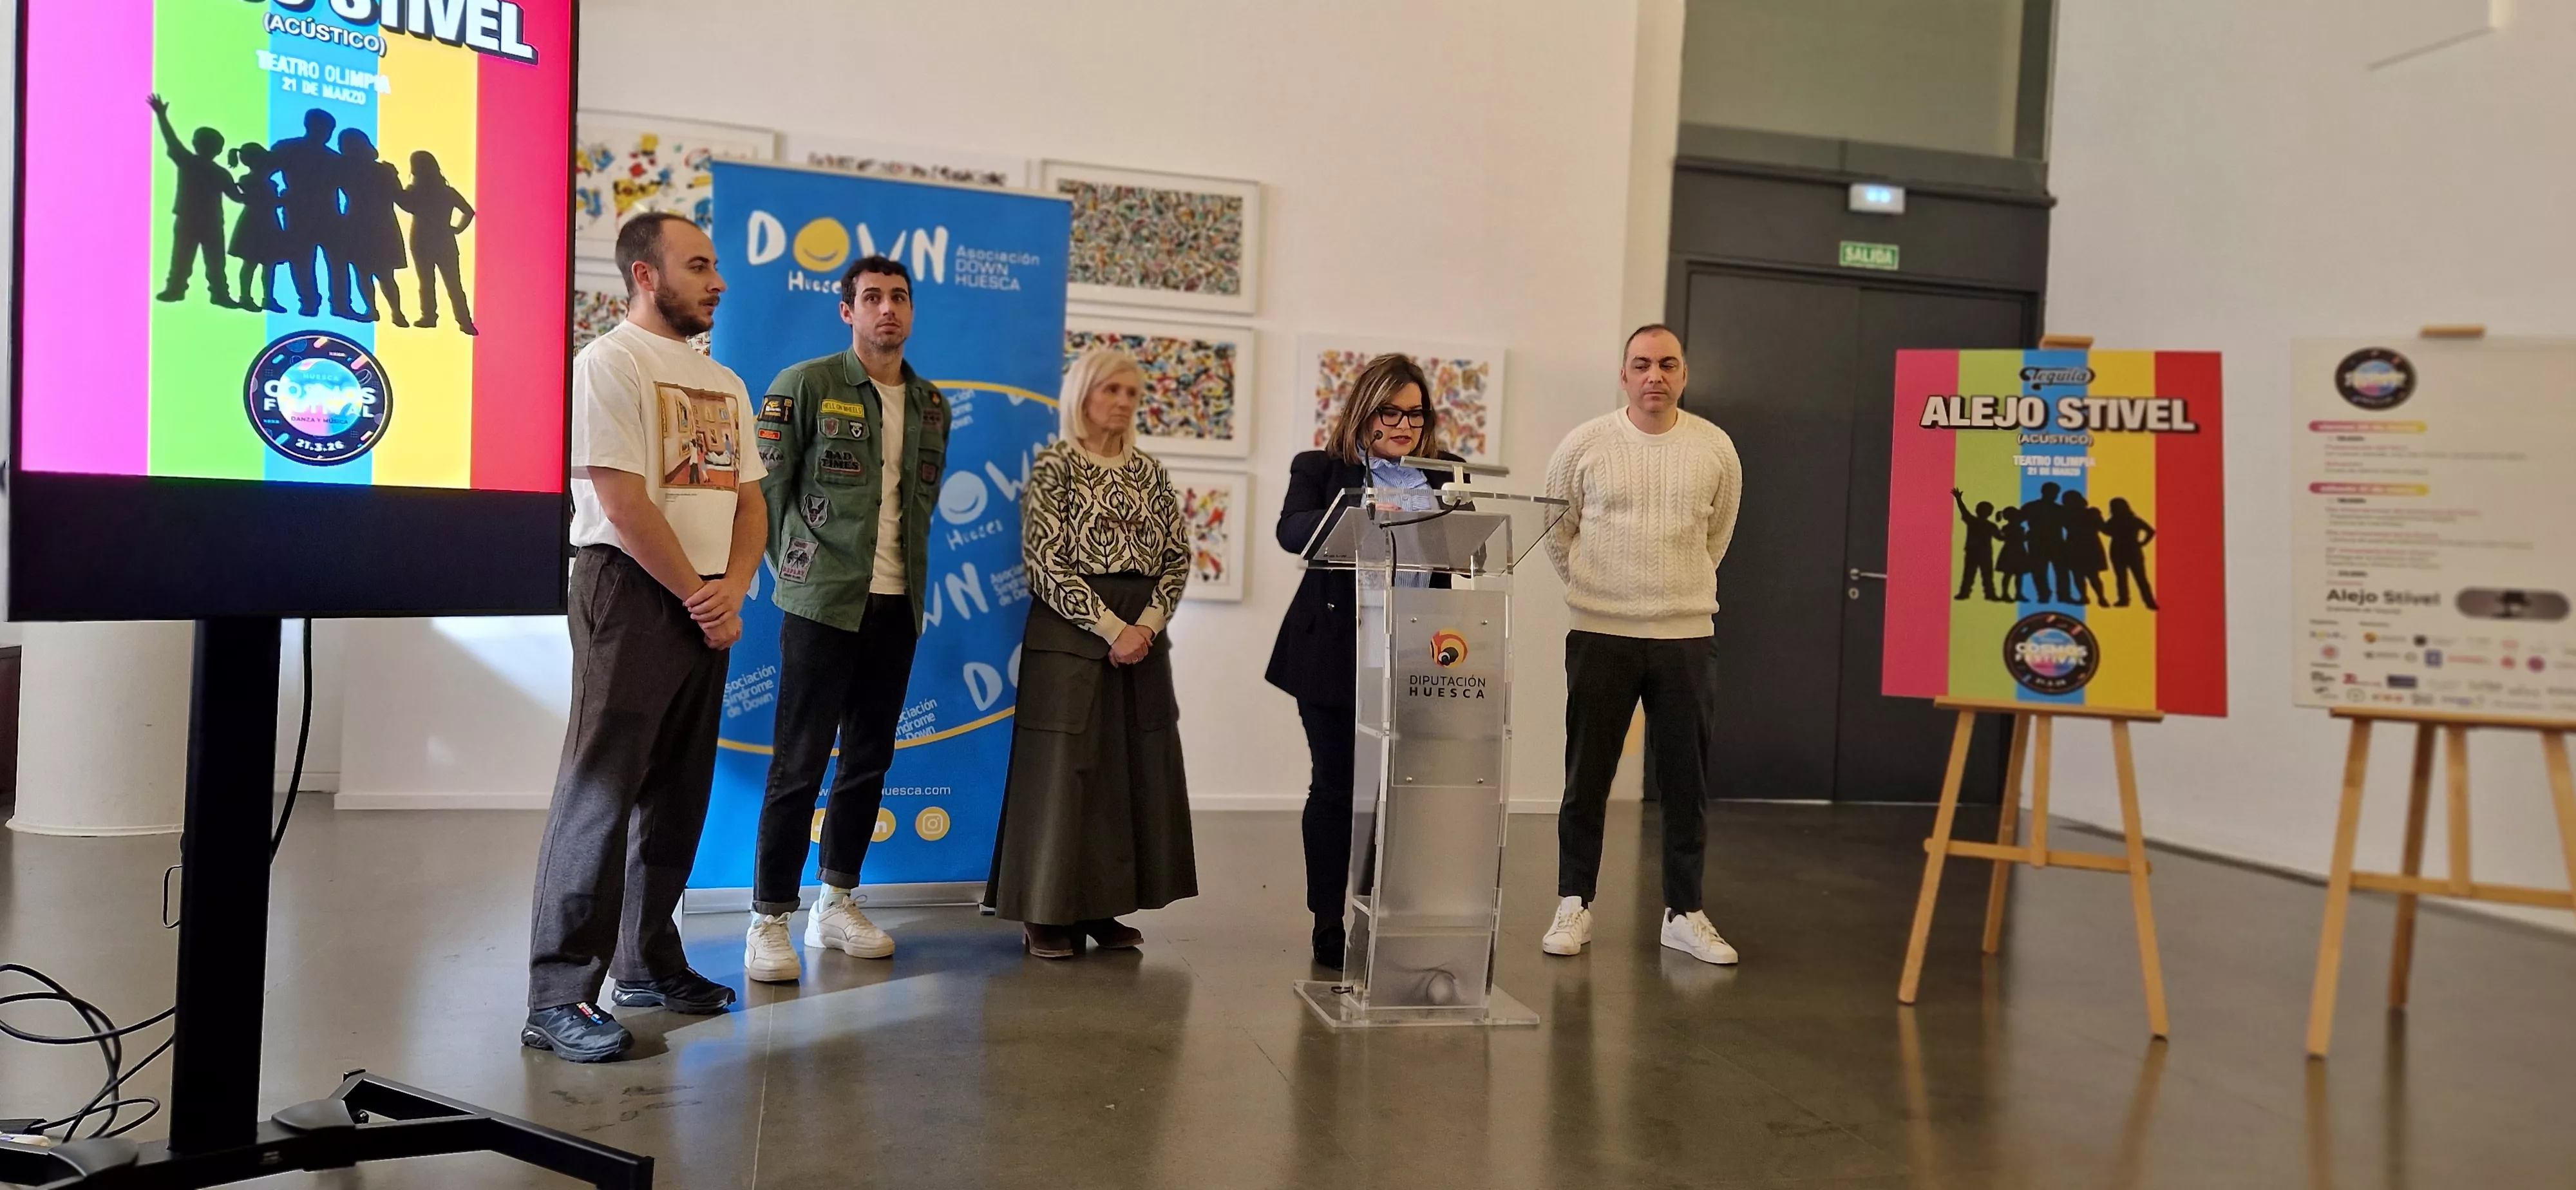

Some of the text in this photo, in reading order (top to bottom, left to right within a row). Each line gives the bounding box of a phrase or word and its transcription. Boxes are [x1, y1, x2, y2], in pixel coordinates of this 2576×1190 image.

[263, 12, 387, 58] (ACÚSTICO)
[256, 49, 392, 95] TEATRO OLIMPIA
[281, 76, 366, 105] 21 DE MARZO
[956, 244, 1041, 267] Asociación
[1844, 247, 1893, 265] SALIDA
[955, 258, 1009, 276] DOWN
[788, 269, 842, 295] Huesc
[954, 272, 1021, 292] HUESCA
[263, 397, 375, 419] FTIVAL
[823, 401, 835, 410] HELL
[1920, 395, 2199, 434] ALEJO STIVEL
[2017, 432, 2094, 448] (ACÚSTICO)
[820, 458, 860, 471] TIMES
[2012, 455, 2096, 468] TEATRO OLIMPIA
[2327, 589, 2378, 606] Alejo
[724, 664, 777, 696] sociación
[1409, 674, 1486, 688] DIPUTACIÓN
[1409, 686, 1485, 699] HUESCA
[898, 697, 938, 723] ciación
